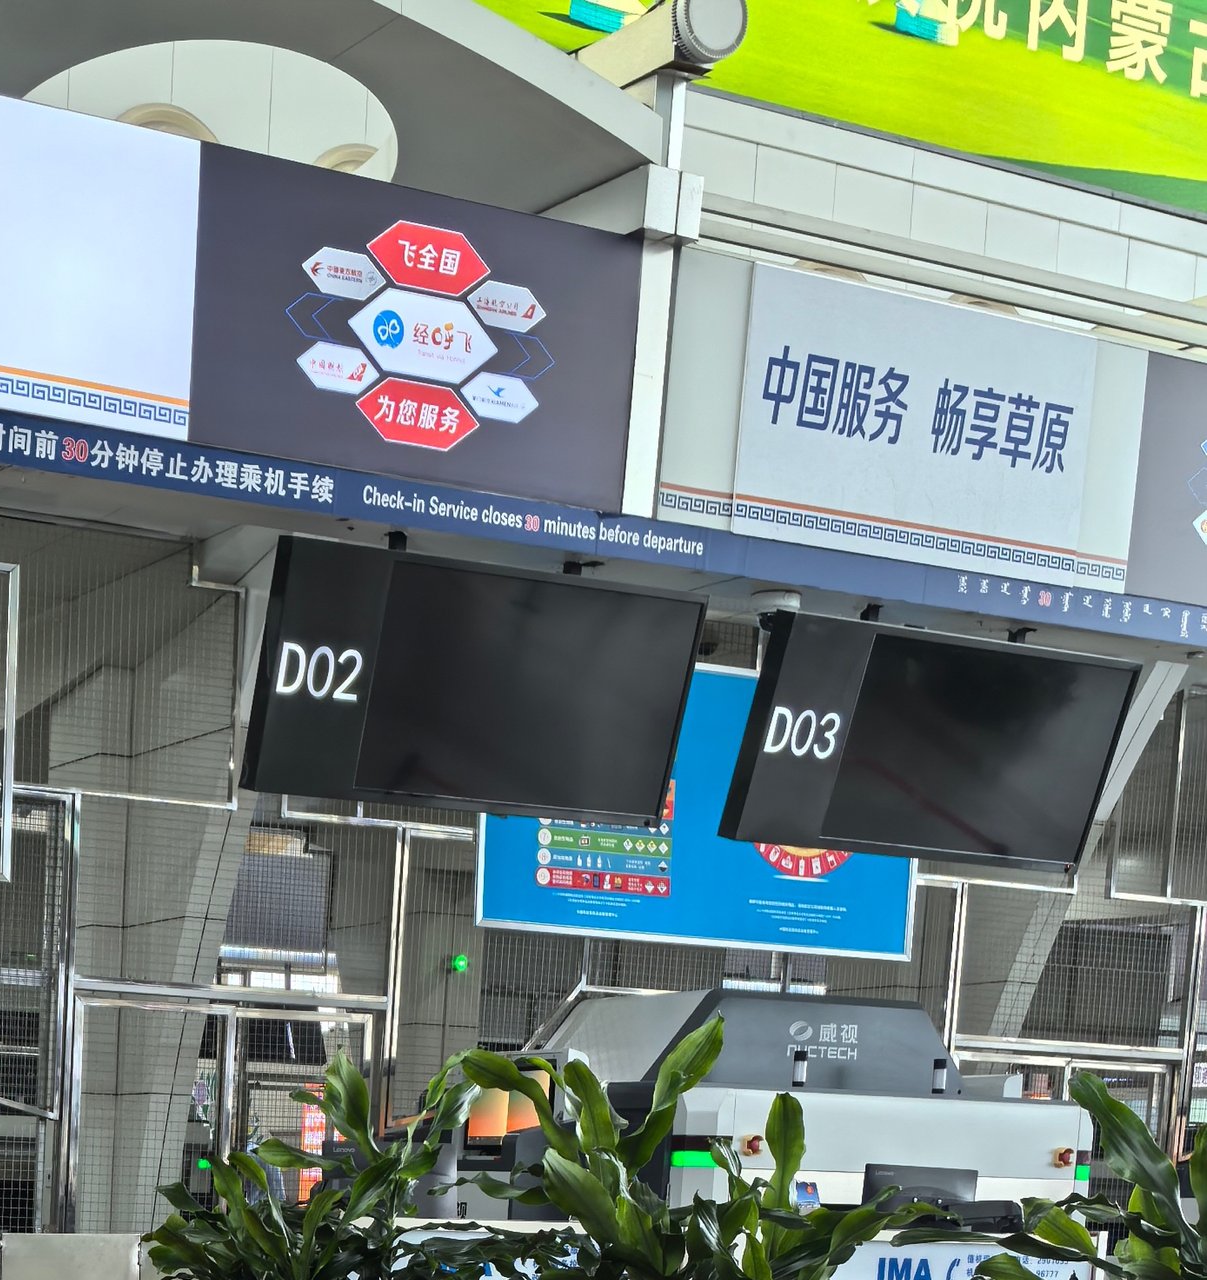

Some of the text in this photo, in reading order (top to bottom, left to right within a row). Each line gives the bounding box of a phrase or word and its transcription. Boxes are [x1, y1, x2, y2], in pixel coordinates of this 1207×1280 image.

[398, 239, 461, 275] 飞全国
[374, 395, 460, 434] 为您服务
[762, 345, 1074, 474] 中国服务 畅享草原
[363, 485, 704, 556] Check-in Service closes 30 minutes before departure
[1038, 590, 1052, 607] 30
[275, 641, 363, 702] D02
[763, 705, 841, 760] D03
[819, 1023, 858, 1043] 威视
